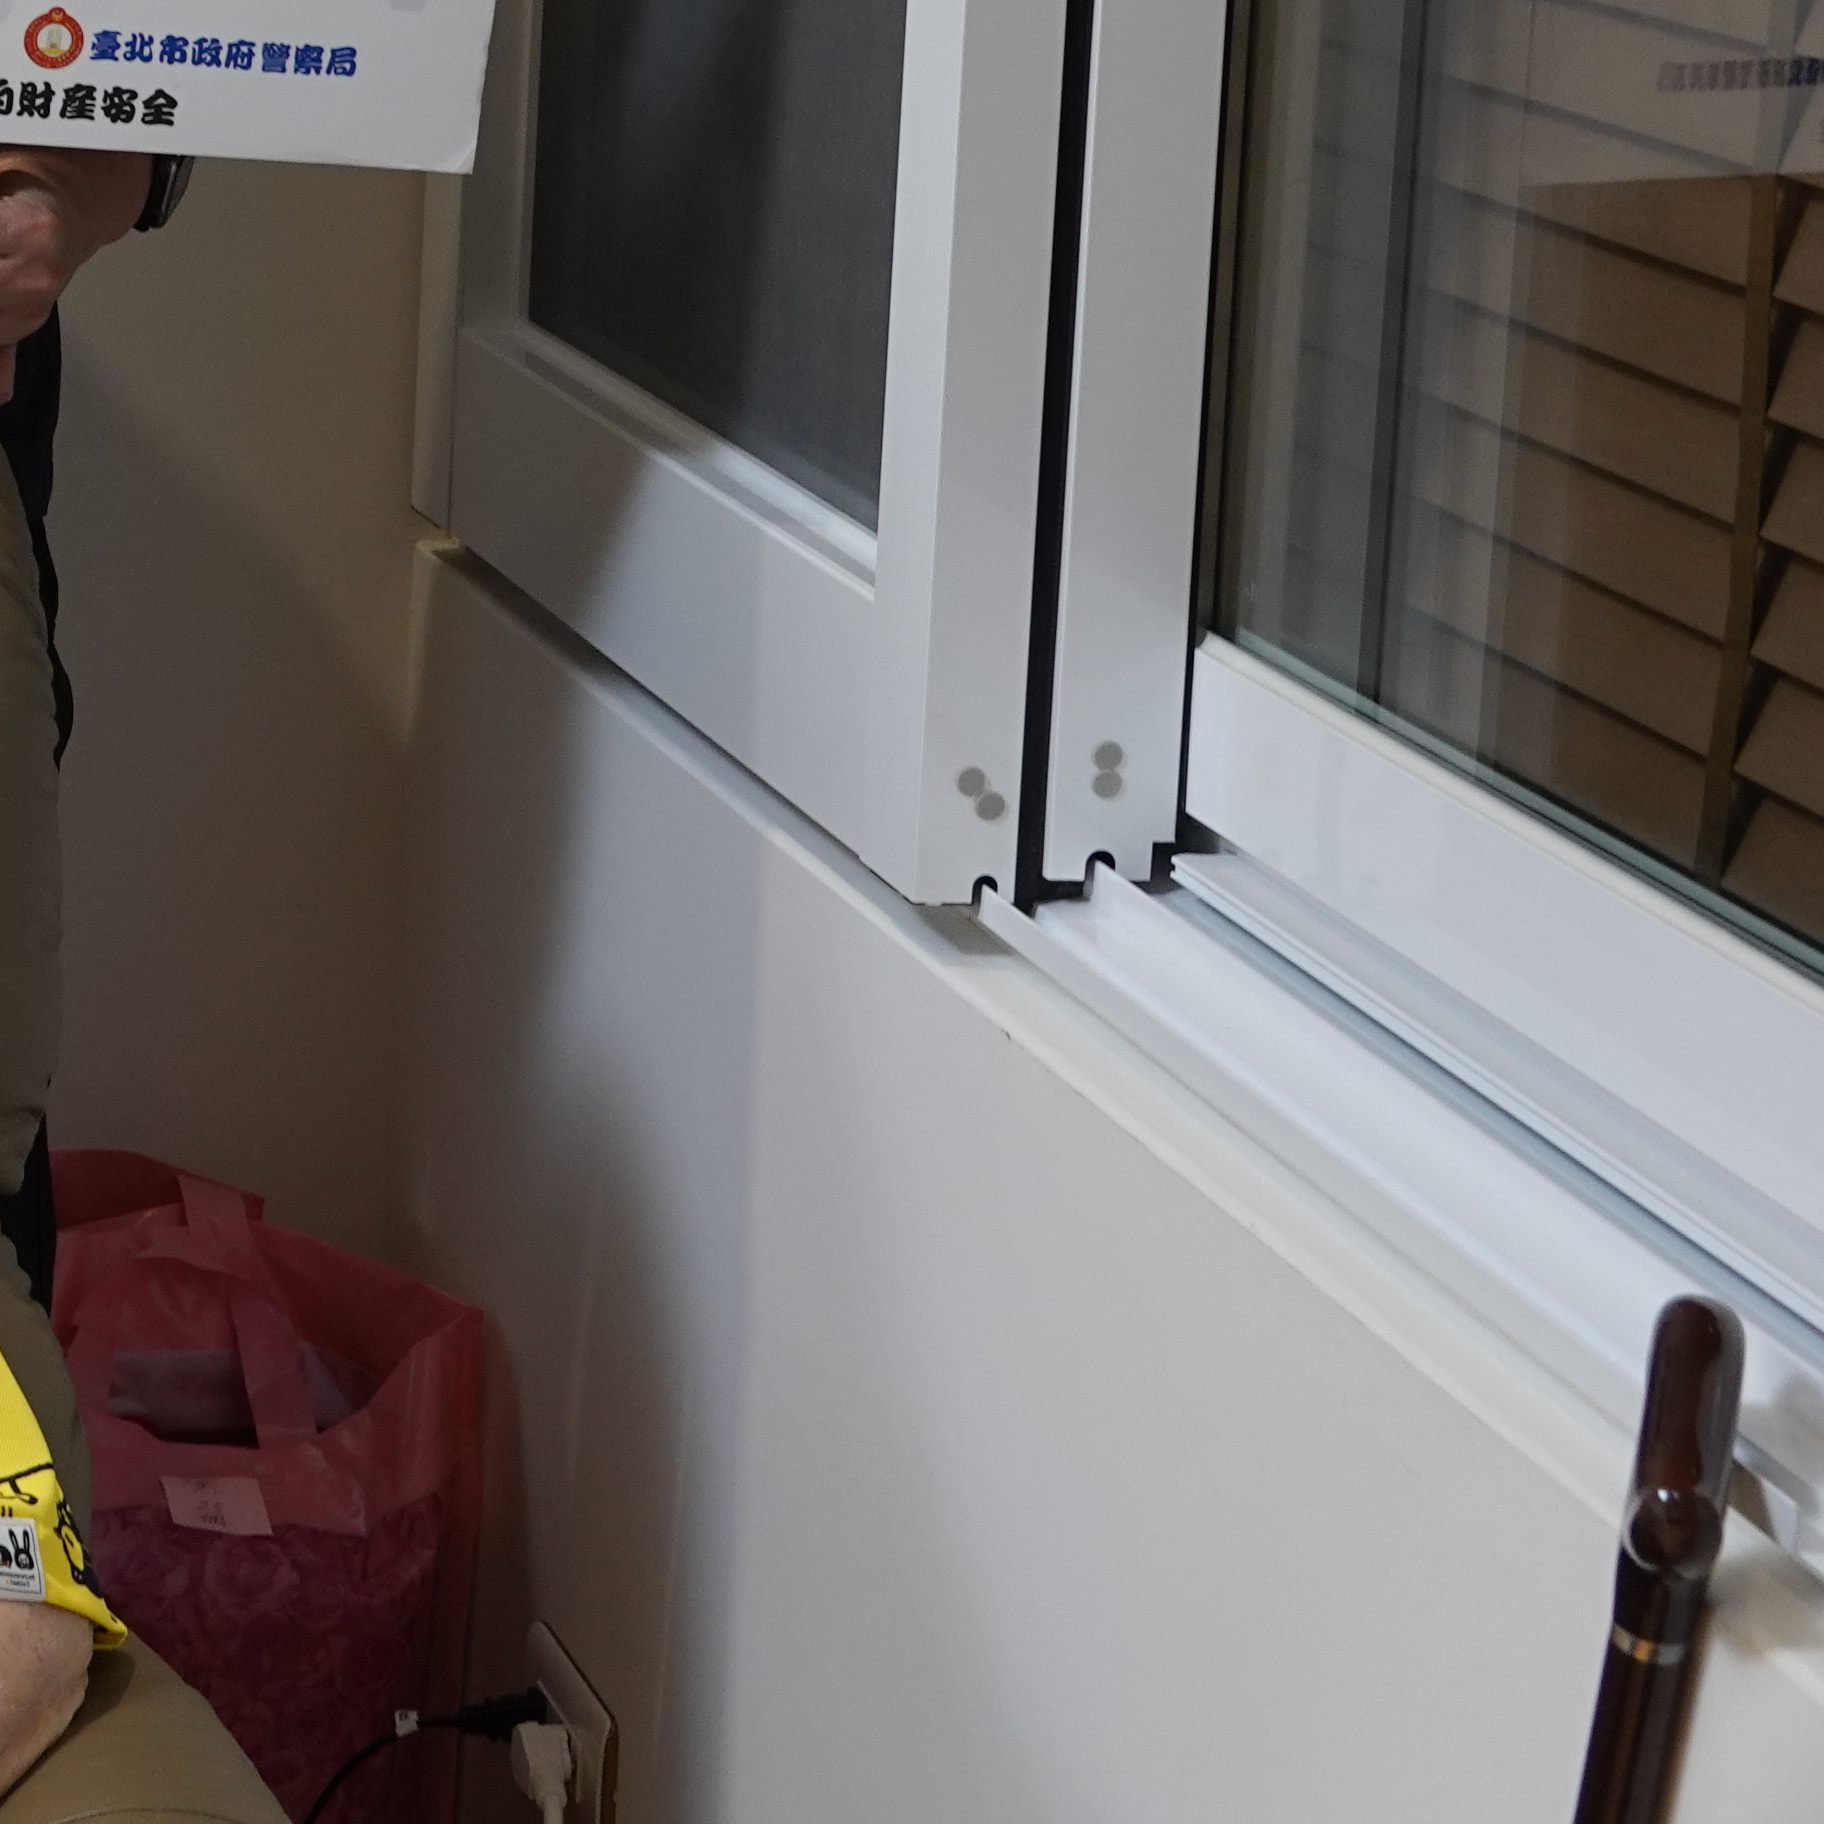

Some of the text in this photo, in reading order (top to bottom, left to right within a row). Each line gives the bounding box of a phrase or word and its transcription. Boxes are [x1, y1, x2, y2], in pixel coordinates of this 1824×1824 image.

[89, 29, 359, 77] 臺北市政府警察局
